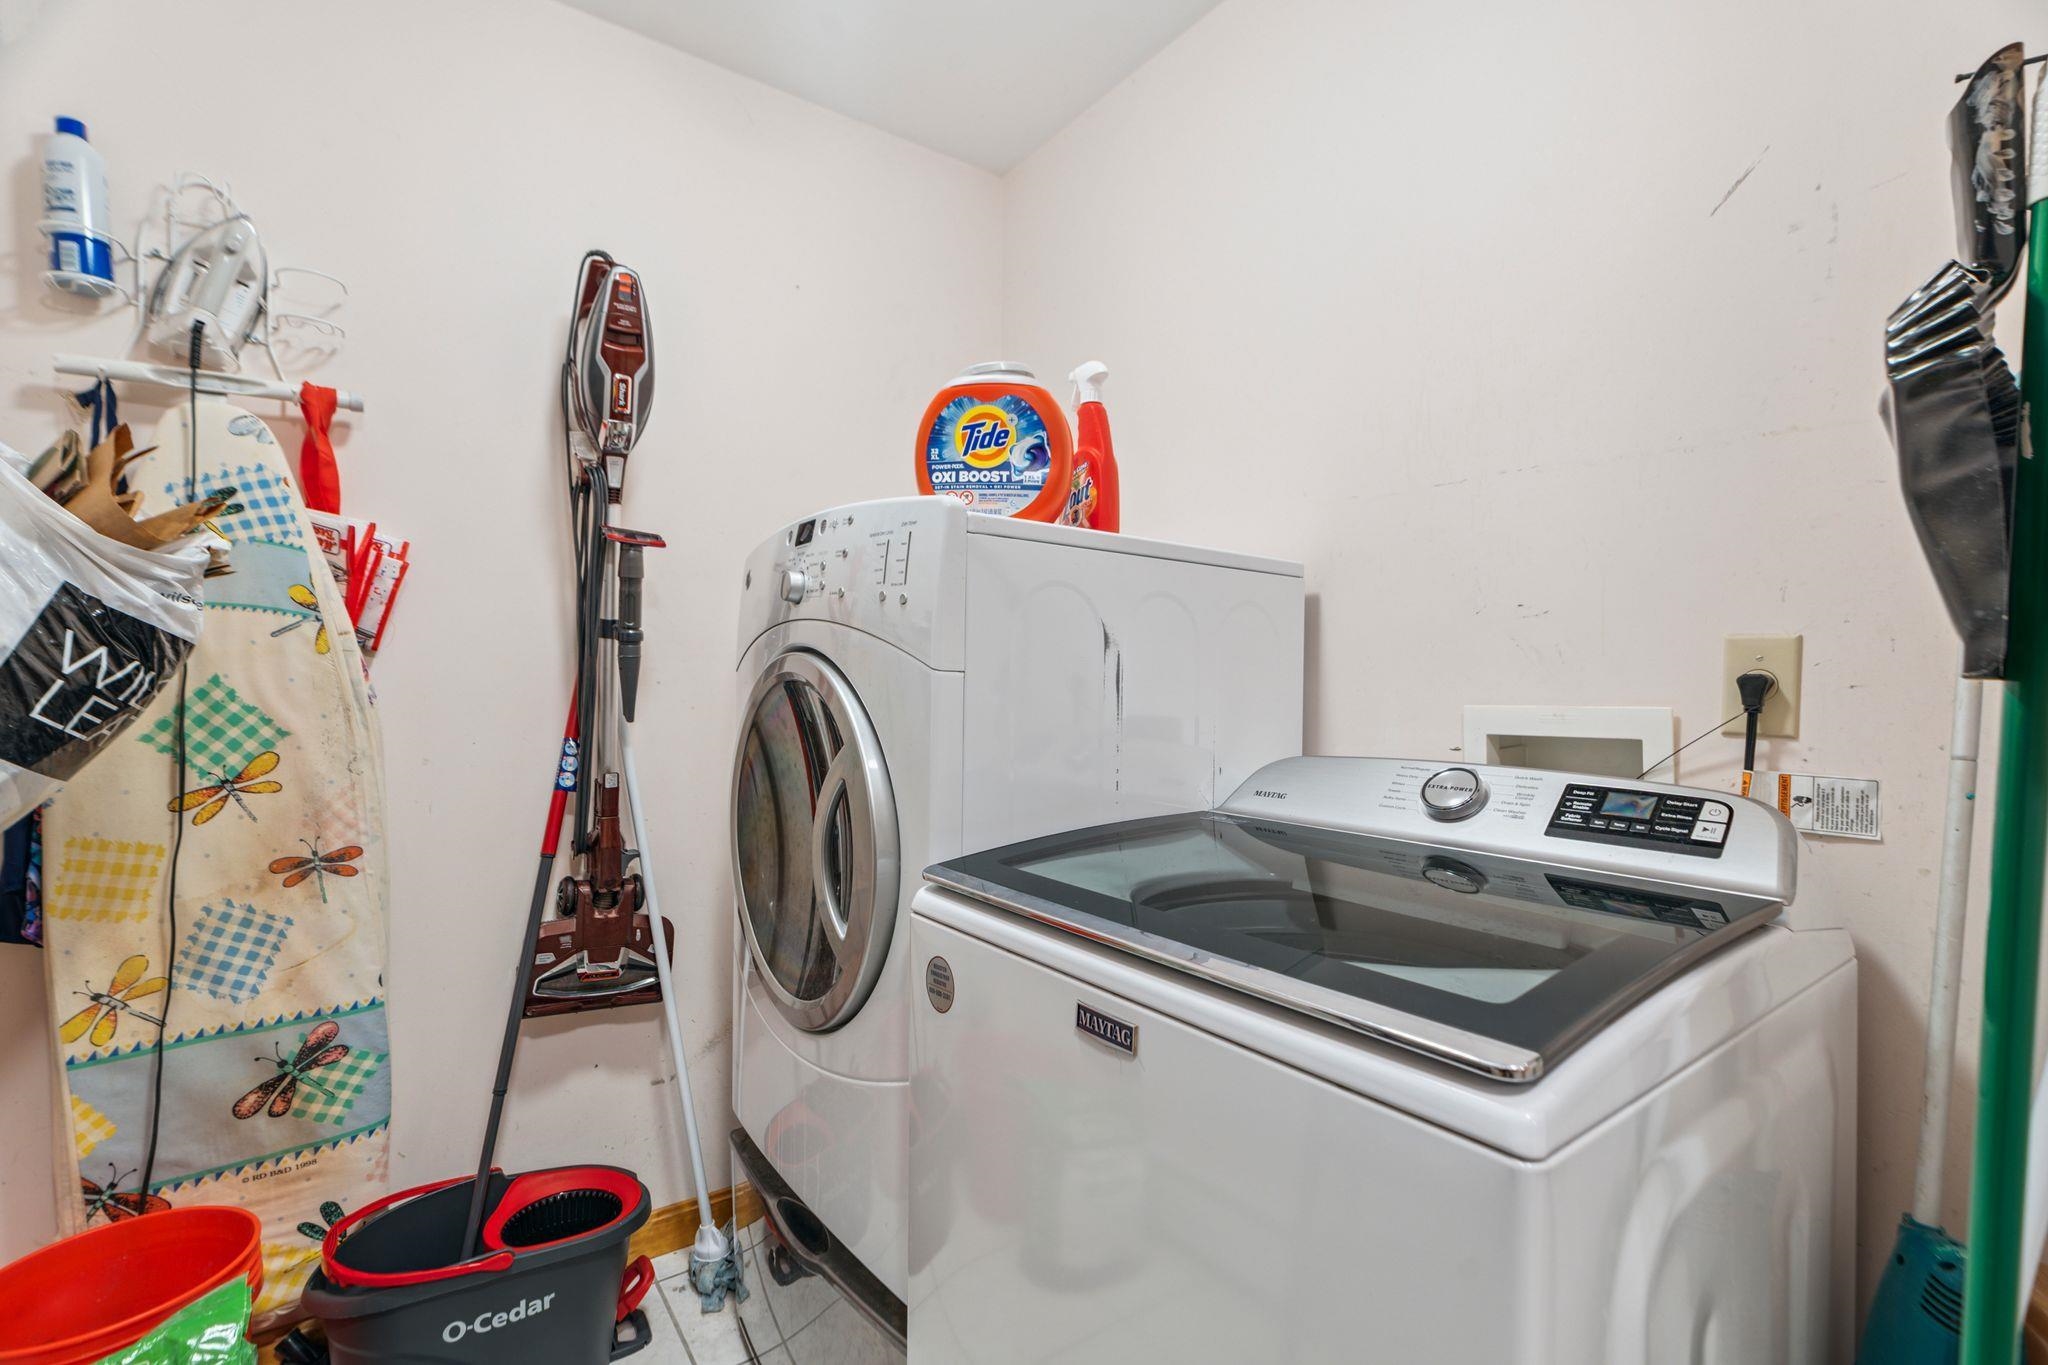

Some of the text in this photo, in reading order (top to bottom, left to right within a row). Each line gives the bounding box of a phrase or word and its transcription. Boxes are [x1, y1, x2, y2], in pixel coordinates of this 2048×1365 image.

[962, 421, 1009, 456] Tide
[932, 471, 1010, 483] OXI BOOST
[1253, 790, 1288, 800] MAYTAG
[1079, 1010, 1130, 1046] MAYTAG
[252, 1173, 267, 1181] RD
[270, 1166, 292, 1176] B&D
[296, 1159, 318, 1170] 1998
[442, 1292, 556, 1343] O-Cedar
